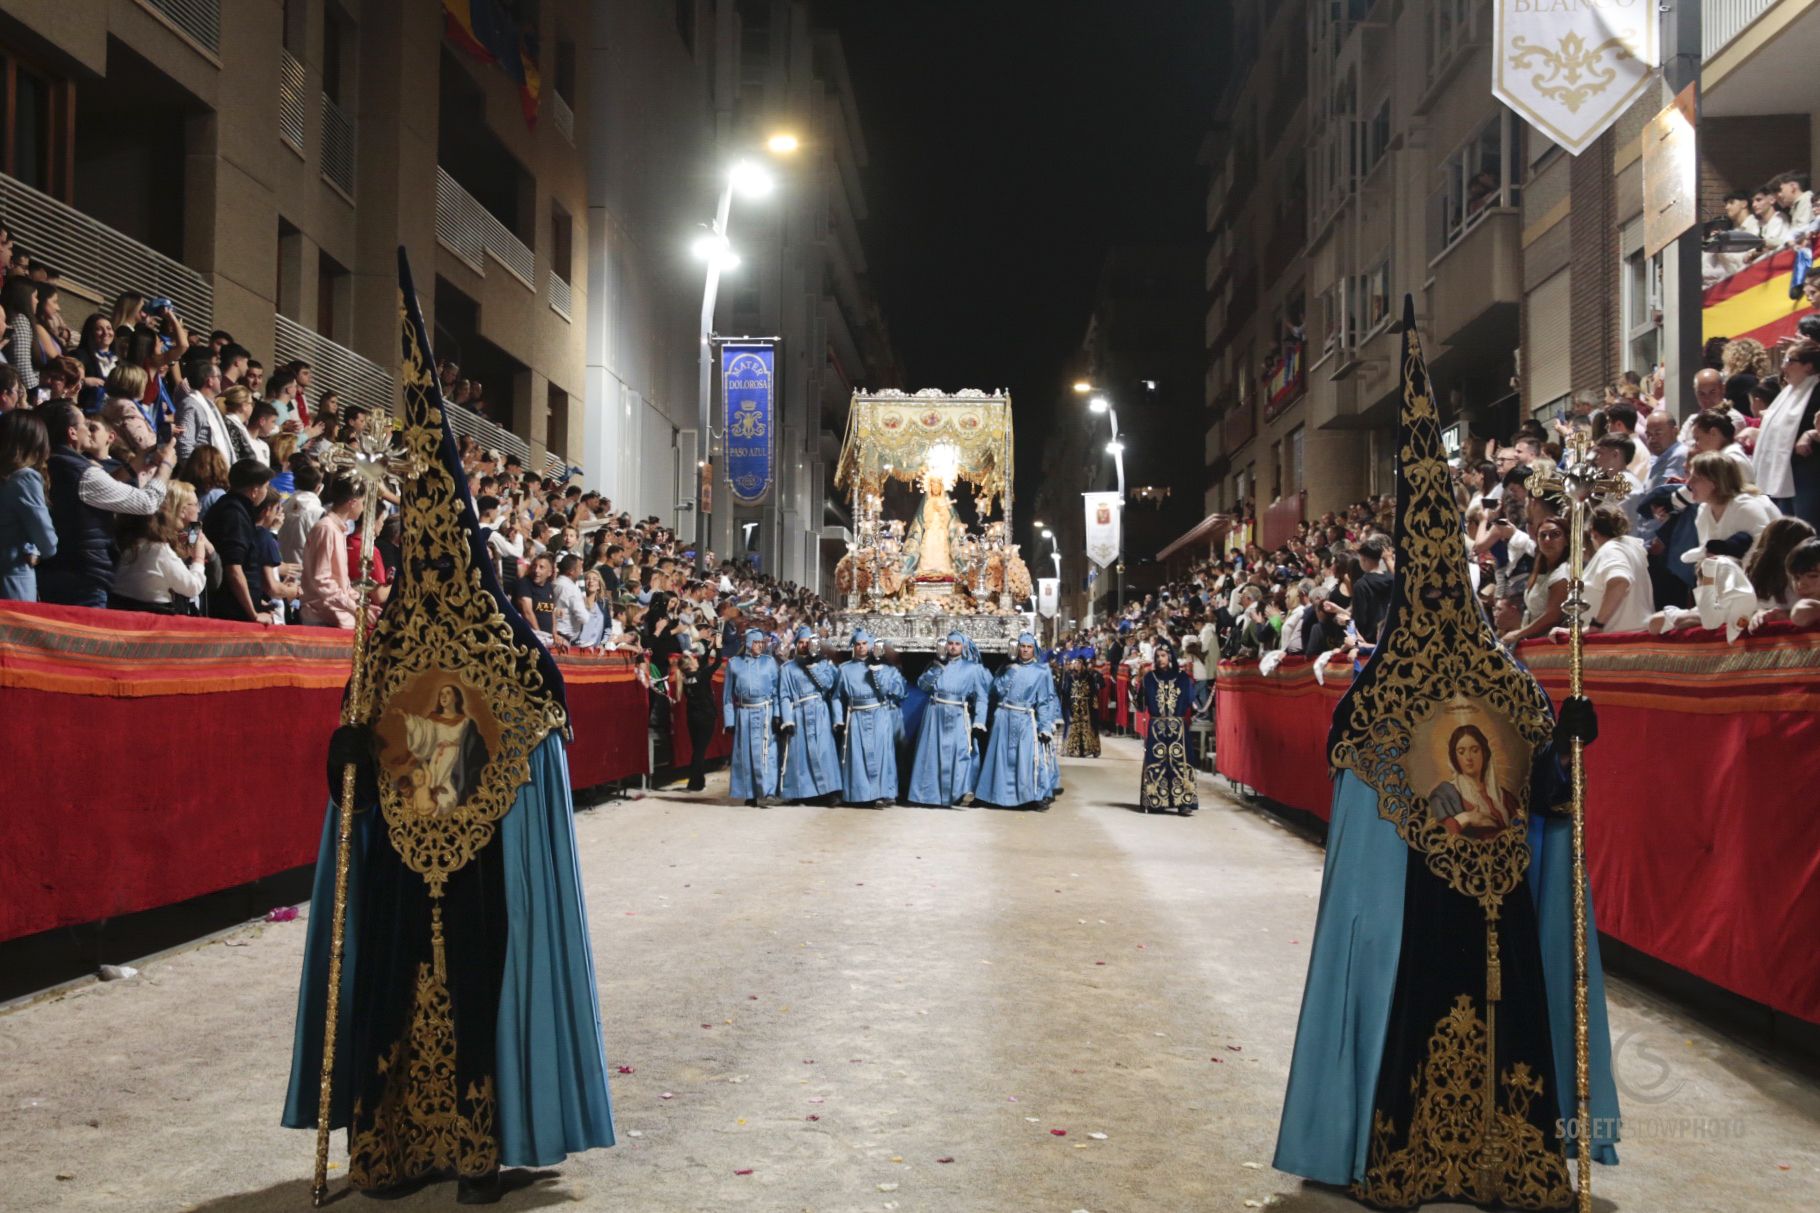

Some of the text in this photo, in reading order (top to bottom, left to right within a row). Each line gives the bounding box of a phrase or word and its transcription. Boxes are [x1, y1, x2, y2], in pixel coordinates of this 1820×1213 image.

[731, 360, 764, 378] MATER
[728, 380, 768, 389] DOLOROSA
[729, 447, 767, 457] PASO AZUL
